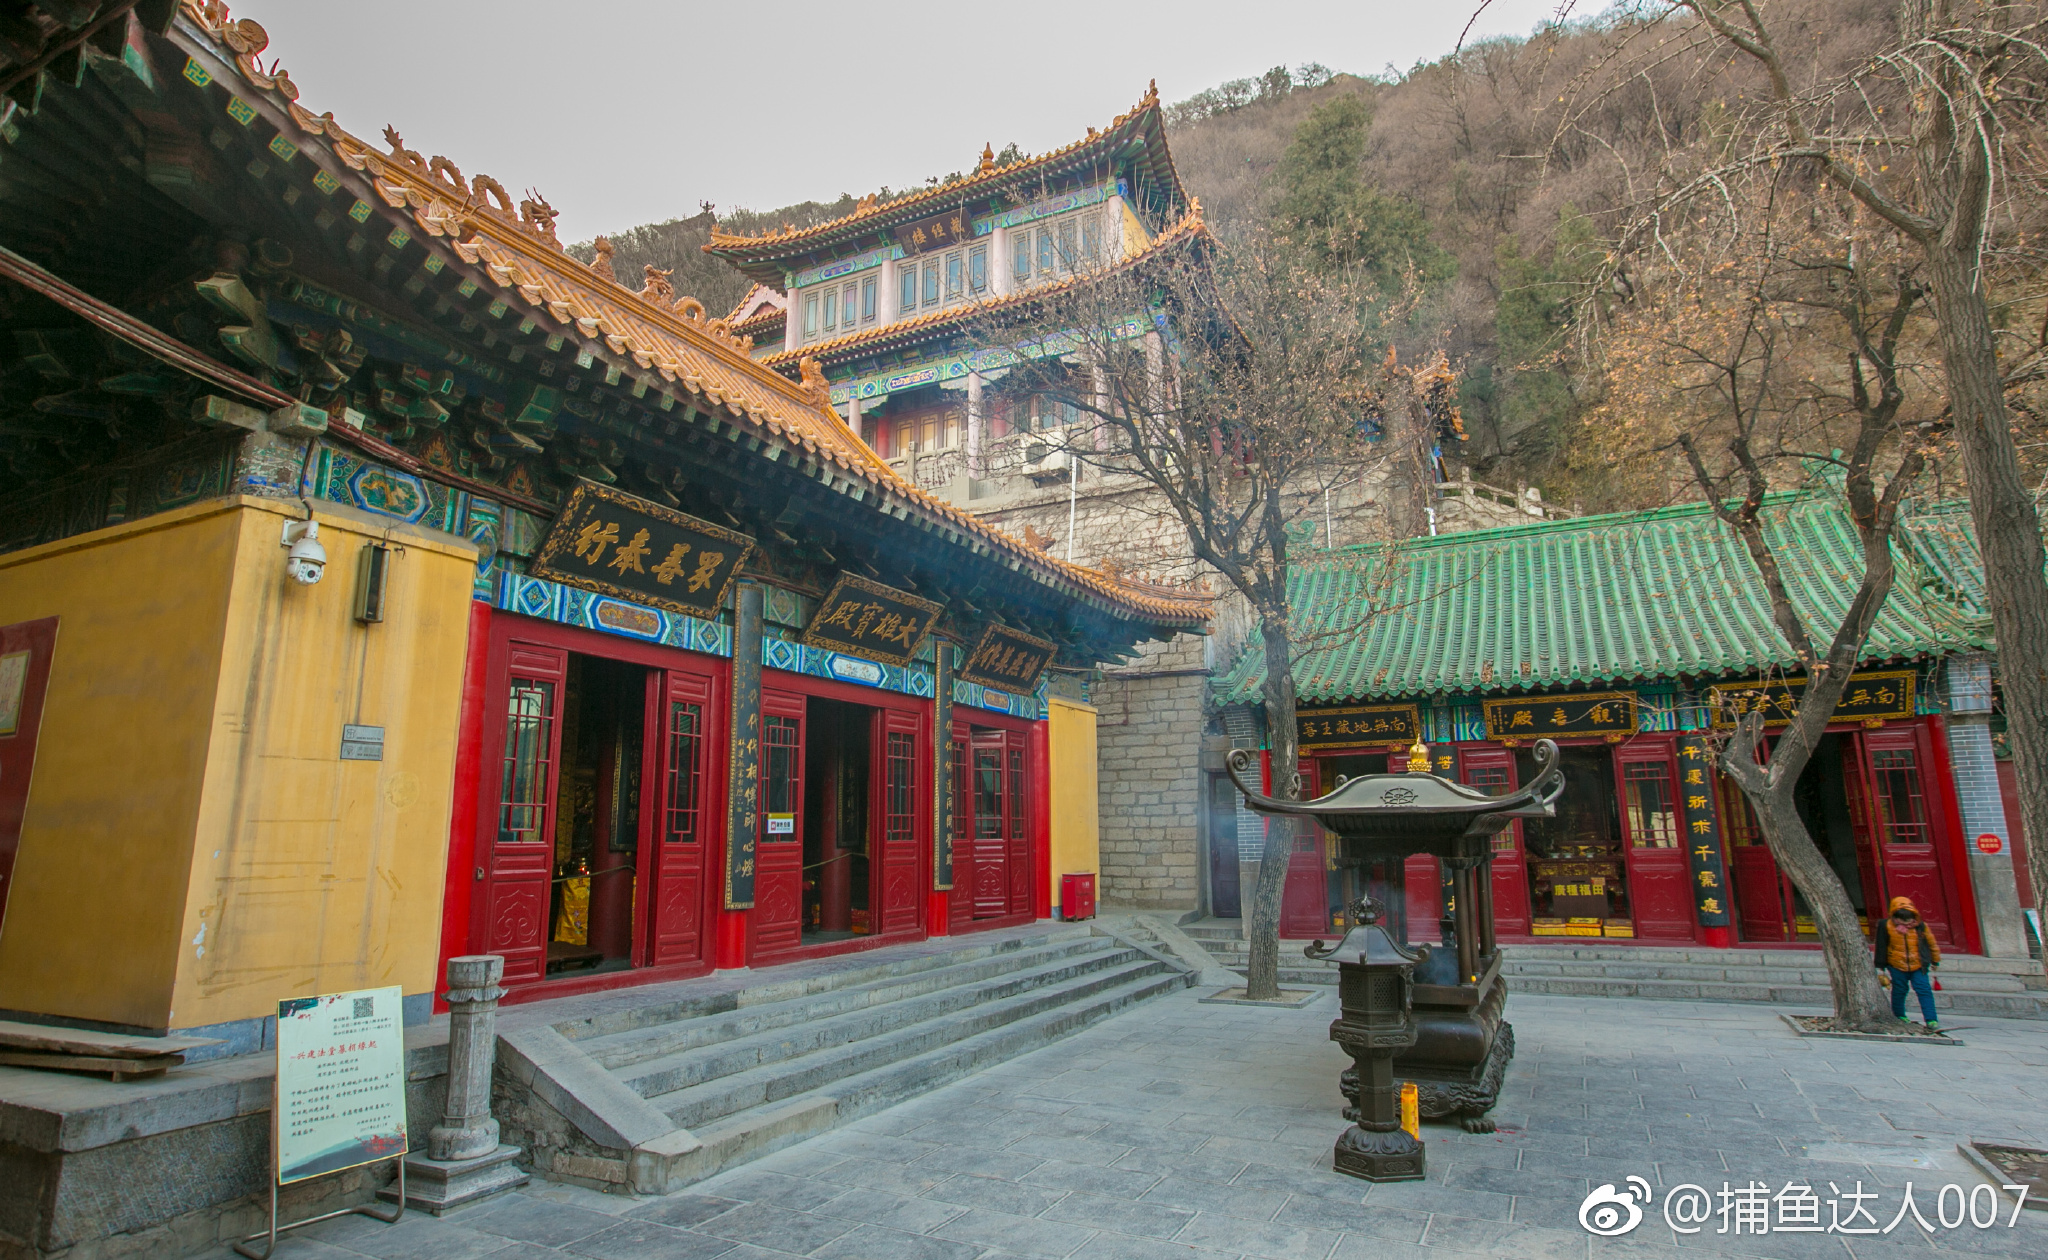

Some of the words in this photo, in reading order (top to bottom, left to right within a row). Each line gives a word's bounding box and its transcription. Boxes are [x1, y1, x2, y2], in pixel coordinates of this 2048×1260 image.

[824, 600, 917, 649] 大雄寶殿
[1297, 716, 1406, 738] 南無地藏王菩
[1554, 884, 1604, 896] 廣種福田
